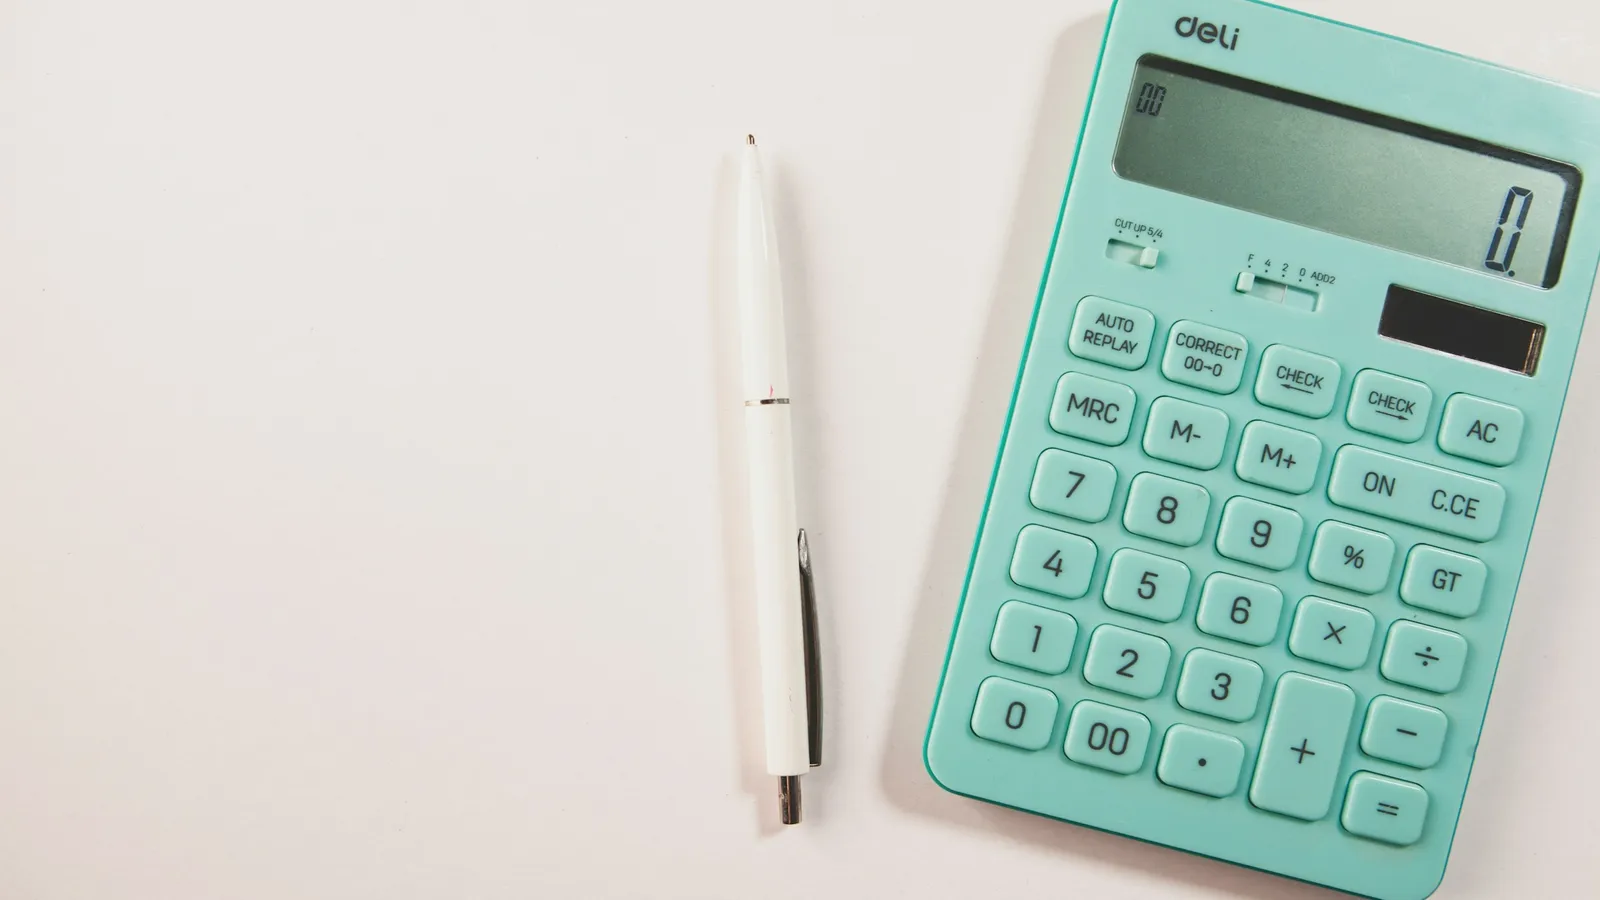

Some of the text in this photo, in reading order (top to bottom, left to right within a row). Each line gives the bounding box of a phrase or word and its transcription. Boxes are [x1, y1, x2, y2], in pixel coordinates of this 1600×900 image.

[1175, 17, 1239, 50] deli
[1115, 218, 1162, 238] CUT UP 5/4
[1248, 253, 1335, 284] F 4 2 0 ADD2
[1096, 313, 1134, 334] AUTO
[1083, 329, 1138, 354] REPLAY
[1176, 333, 1242, 360] CORRECT
[1277, 366, 1324, 390] CHECK
[1067, 393, 1119, 424] MRC
[1368, 391, 1416, 416] CHECK
[1467, 420, 1498, 443] AC
[1261, 444, 1296, 468] M+
[1066, 471, 1085, 498] 7
[1363, 472, 1479, 519] ON C.CE
[1157, 496, 1178, 524] 8
[1251, 520, 1271, 548] 9
[1043, 550, 1062, 577] 4
[1344, 546, 1364, 569] %
[1138, 572, 1158, 599] 5
[1432, 569, 1462, 591] GT
[1231, 596, 1251, 624] 6
[1032, 625, 1041, 652] 1
[1116, 649, 1138, 678] 2
[1211, 673, 1231, 700] 3
[1005, 702, 1026, 729] 0
[1088, 723, 1129, 755] 00
